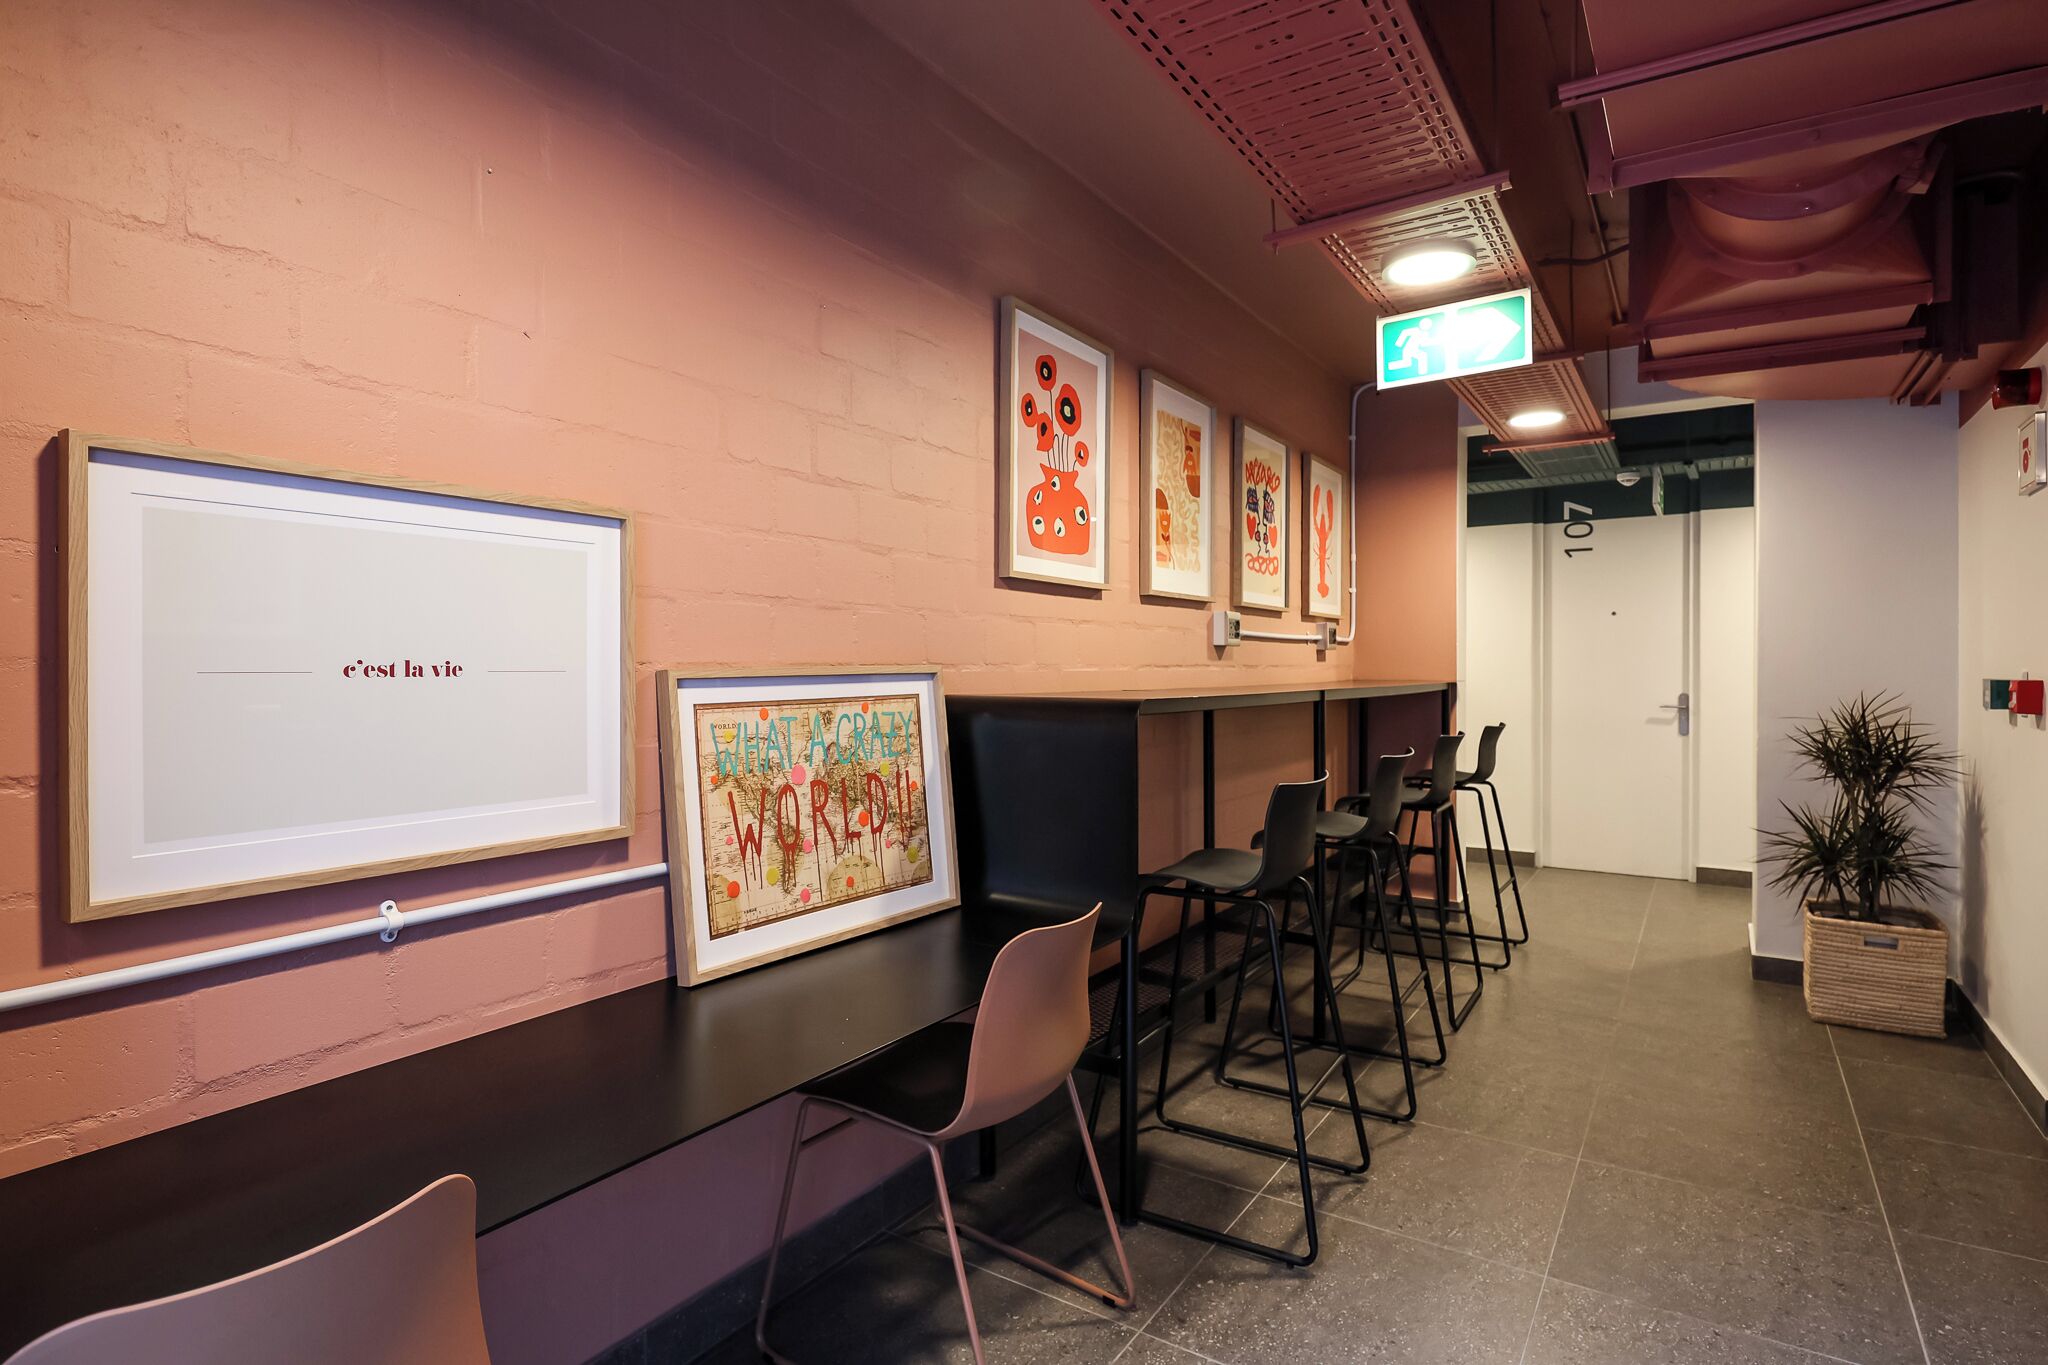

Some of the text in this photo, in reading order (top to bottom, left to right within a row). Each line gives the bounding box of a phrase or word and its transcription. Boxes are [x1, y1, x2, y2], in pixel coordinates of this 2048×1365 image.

[1563, 501, 1594, 558] 107
[343, 659, 463, 678] c'est la vie
[710, 710, 913, 777] WHAT A CRAZY
